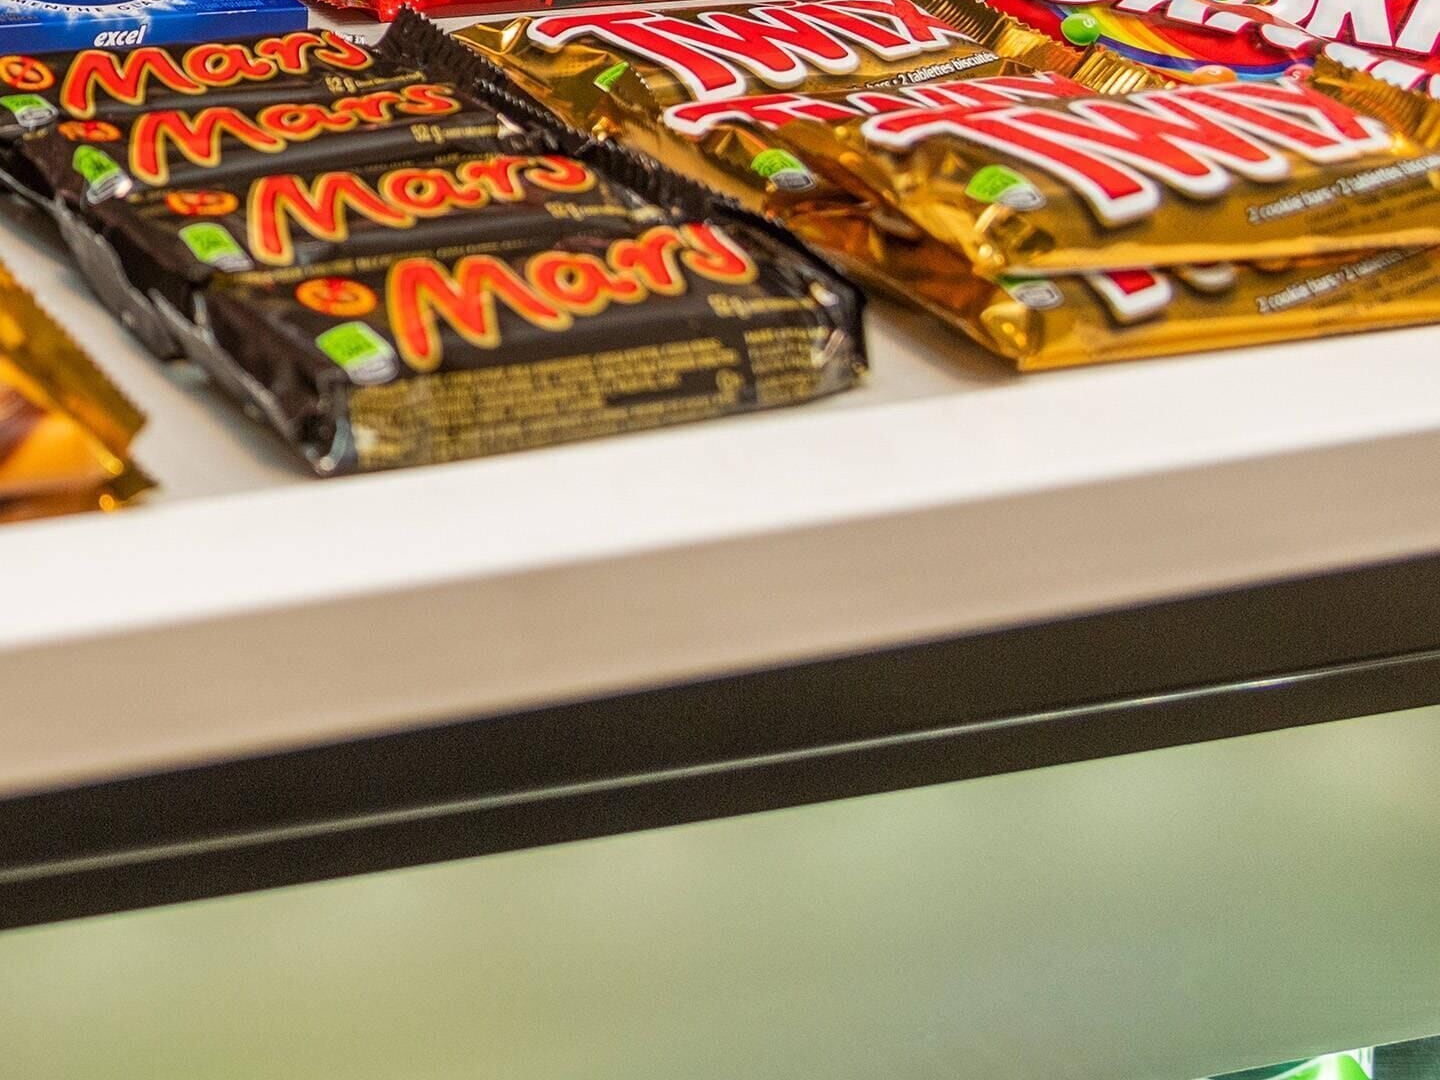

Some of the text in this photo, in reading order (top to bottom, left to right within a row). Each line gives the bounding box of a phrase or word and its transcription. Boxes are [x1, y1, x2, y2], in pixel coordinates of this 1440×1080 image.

[62, 30, 373, 119] Mars
[93, 24, 148, 47] excel
[898, 61, 953, 87] 2 tablettes
[130, 83, 461, 186] Mars
[862, 78, 1395, 226] TWIX
[247, 154, 597, 266] Mars
[1302, 187, 1335, 208] bars
[387, 222, 759, 371] Mars
